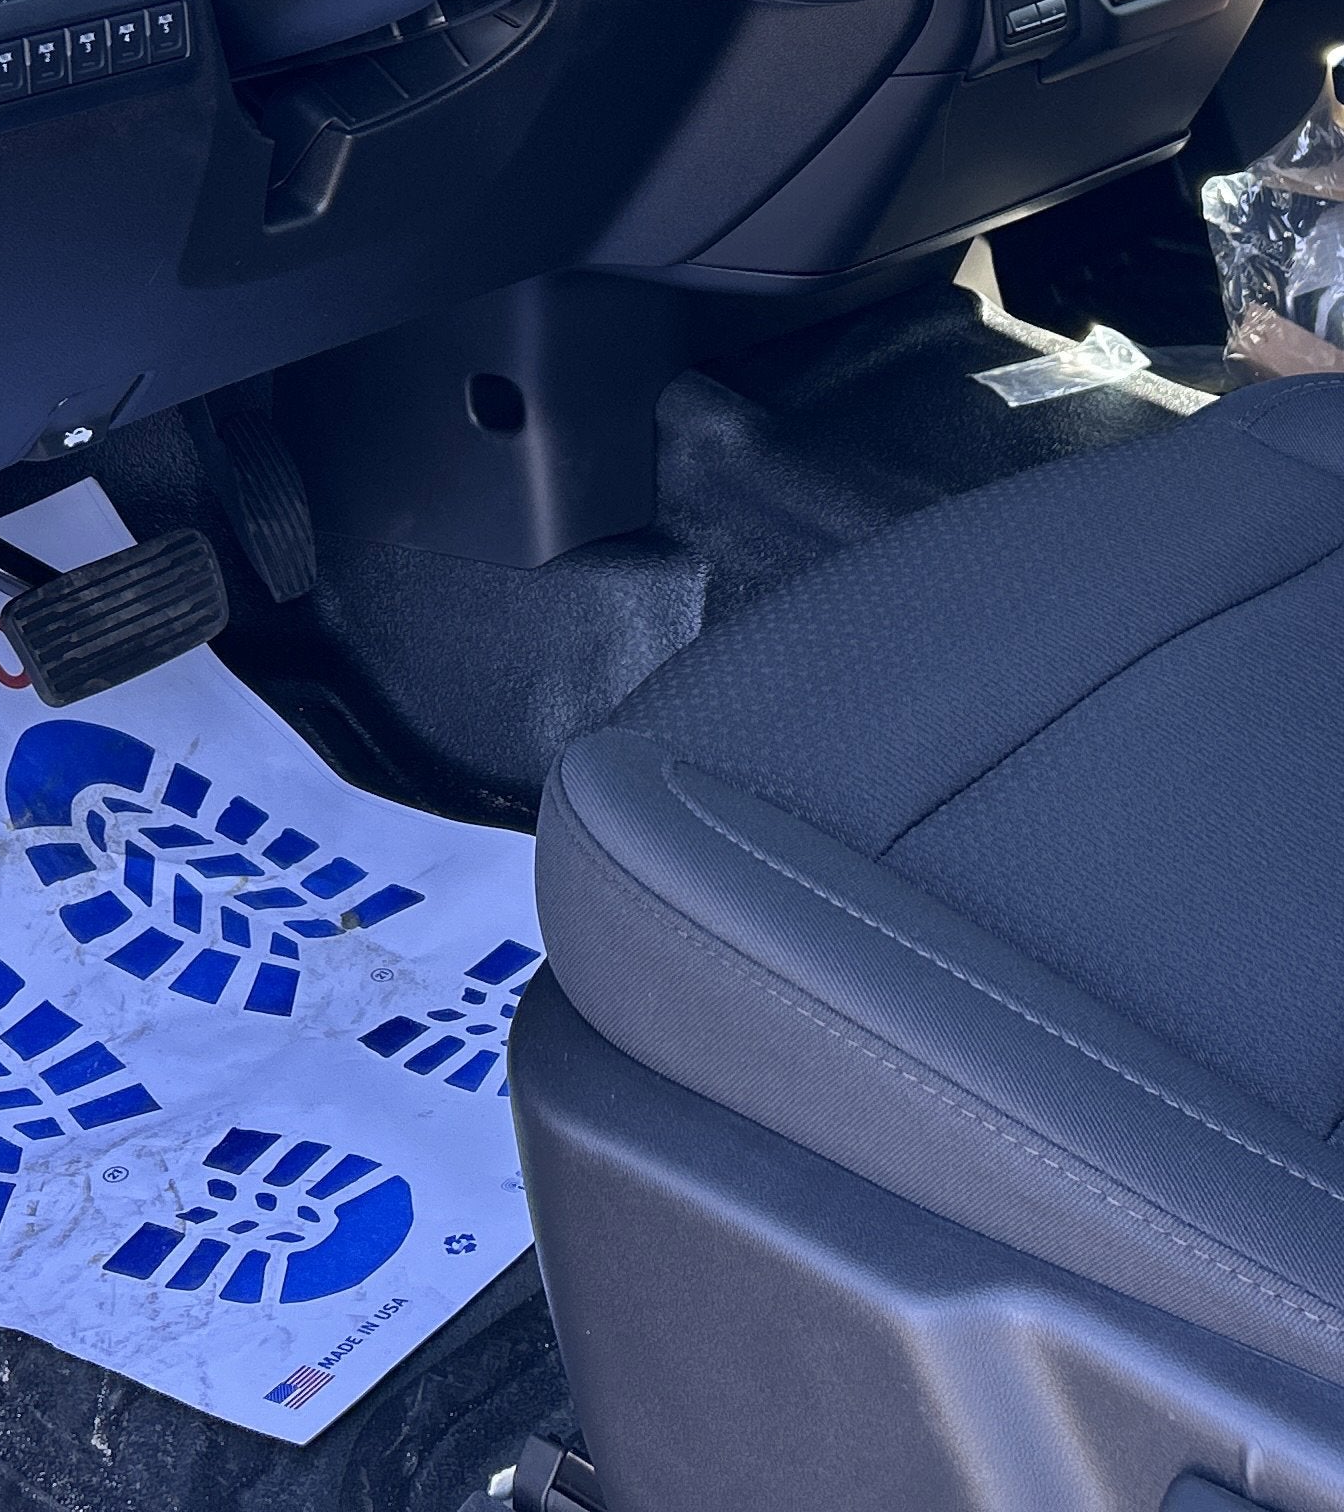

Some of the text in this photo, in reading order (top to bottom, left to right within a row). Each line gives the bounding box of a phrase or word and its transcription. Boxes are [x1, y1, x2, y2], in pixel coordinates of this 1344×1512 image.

[317, 1297, 409, 1370] MADE IN USA
